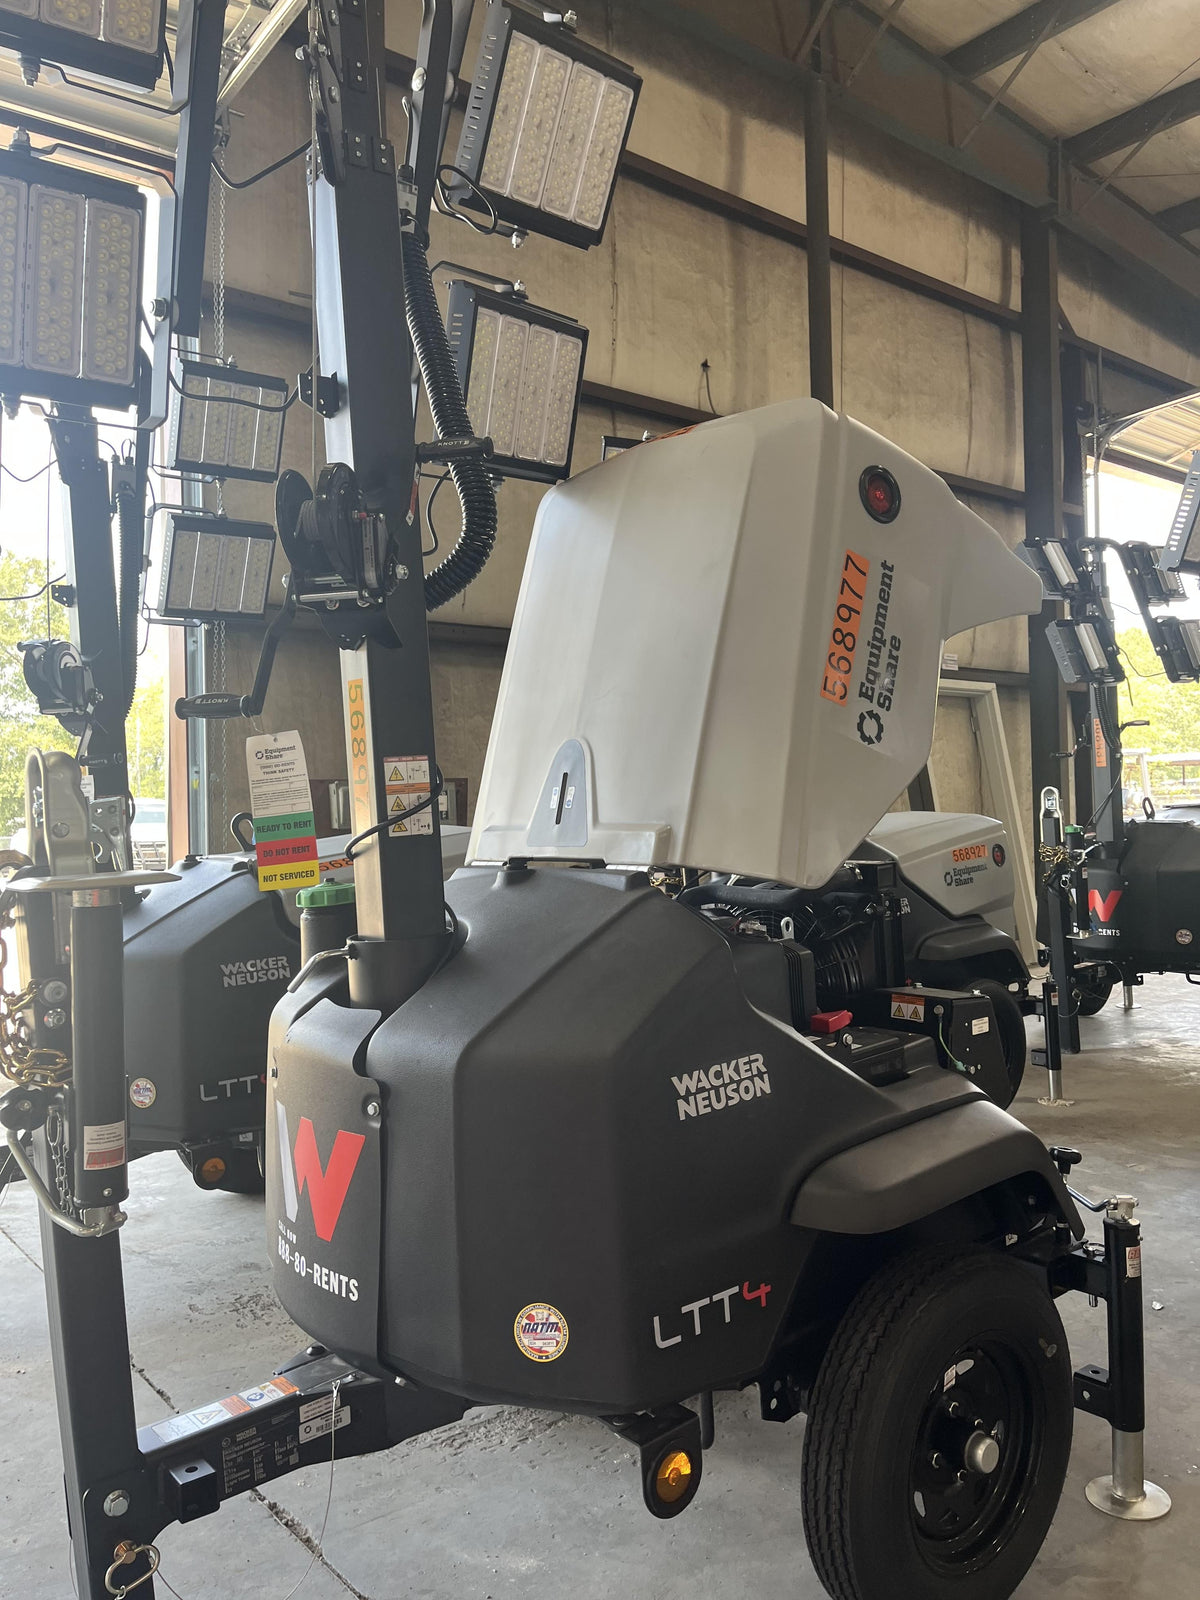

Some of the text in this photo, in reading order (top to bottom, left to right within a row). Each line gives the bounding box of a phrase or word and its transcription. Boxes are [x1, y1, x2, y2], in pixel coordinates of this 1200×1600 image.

[823, 554, 867, 701] 568977
[858, 559, 895, 703] Equipment
[876, 635, 901, 712] Share
[264, 745, 296, 754] Equipment
[256, 819, 312, 833] READY TO RENT
[263, 845, 310, 858] DO NOT RENT
[952, 845, 987, 863] 568927
[263, 869, 315, 883] NOT SERVICED
[952, 863, 988, 877] Equipment
[954, 876, 974, 887] Share
[220, 955, 289, 976] WACKER
[222, 966, 291, 988] NEUSON
[670, 1053, 768, 1097] WACKER
[199, 1074, 265, 1102] LTT
[676, 1073, 772, 1121] NEUSON
[653, 1280, 772, 1349] LTT4
